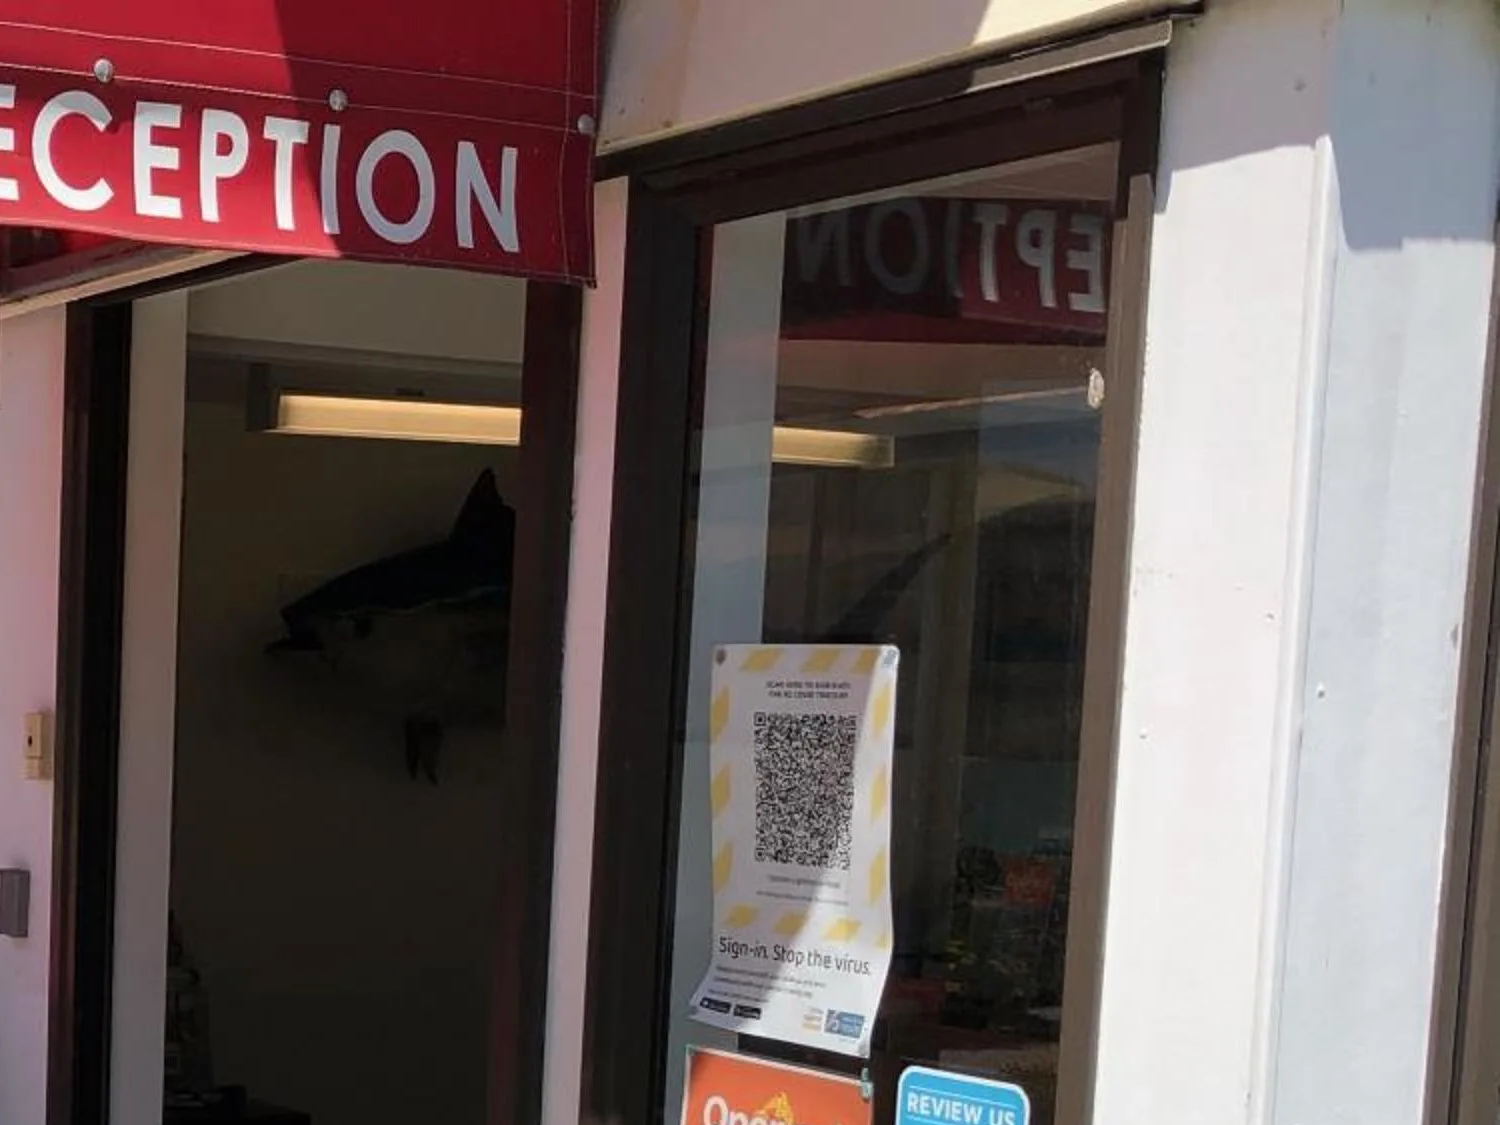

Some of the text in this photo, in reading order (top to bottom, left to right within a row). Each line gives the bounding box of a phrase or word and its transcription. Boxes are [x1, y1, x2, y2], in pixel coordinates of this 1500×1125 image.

[773, 944, 803, 967] Stop
[807, 949, 831, 968] the
[907, 1091, 984, 1125] REVIEW
